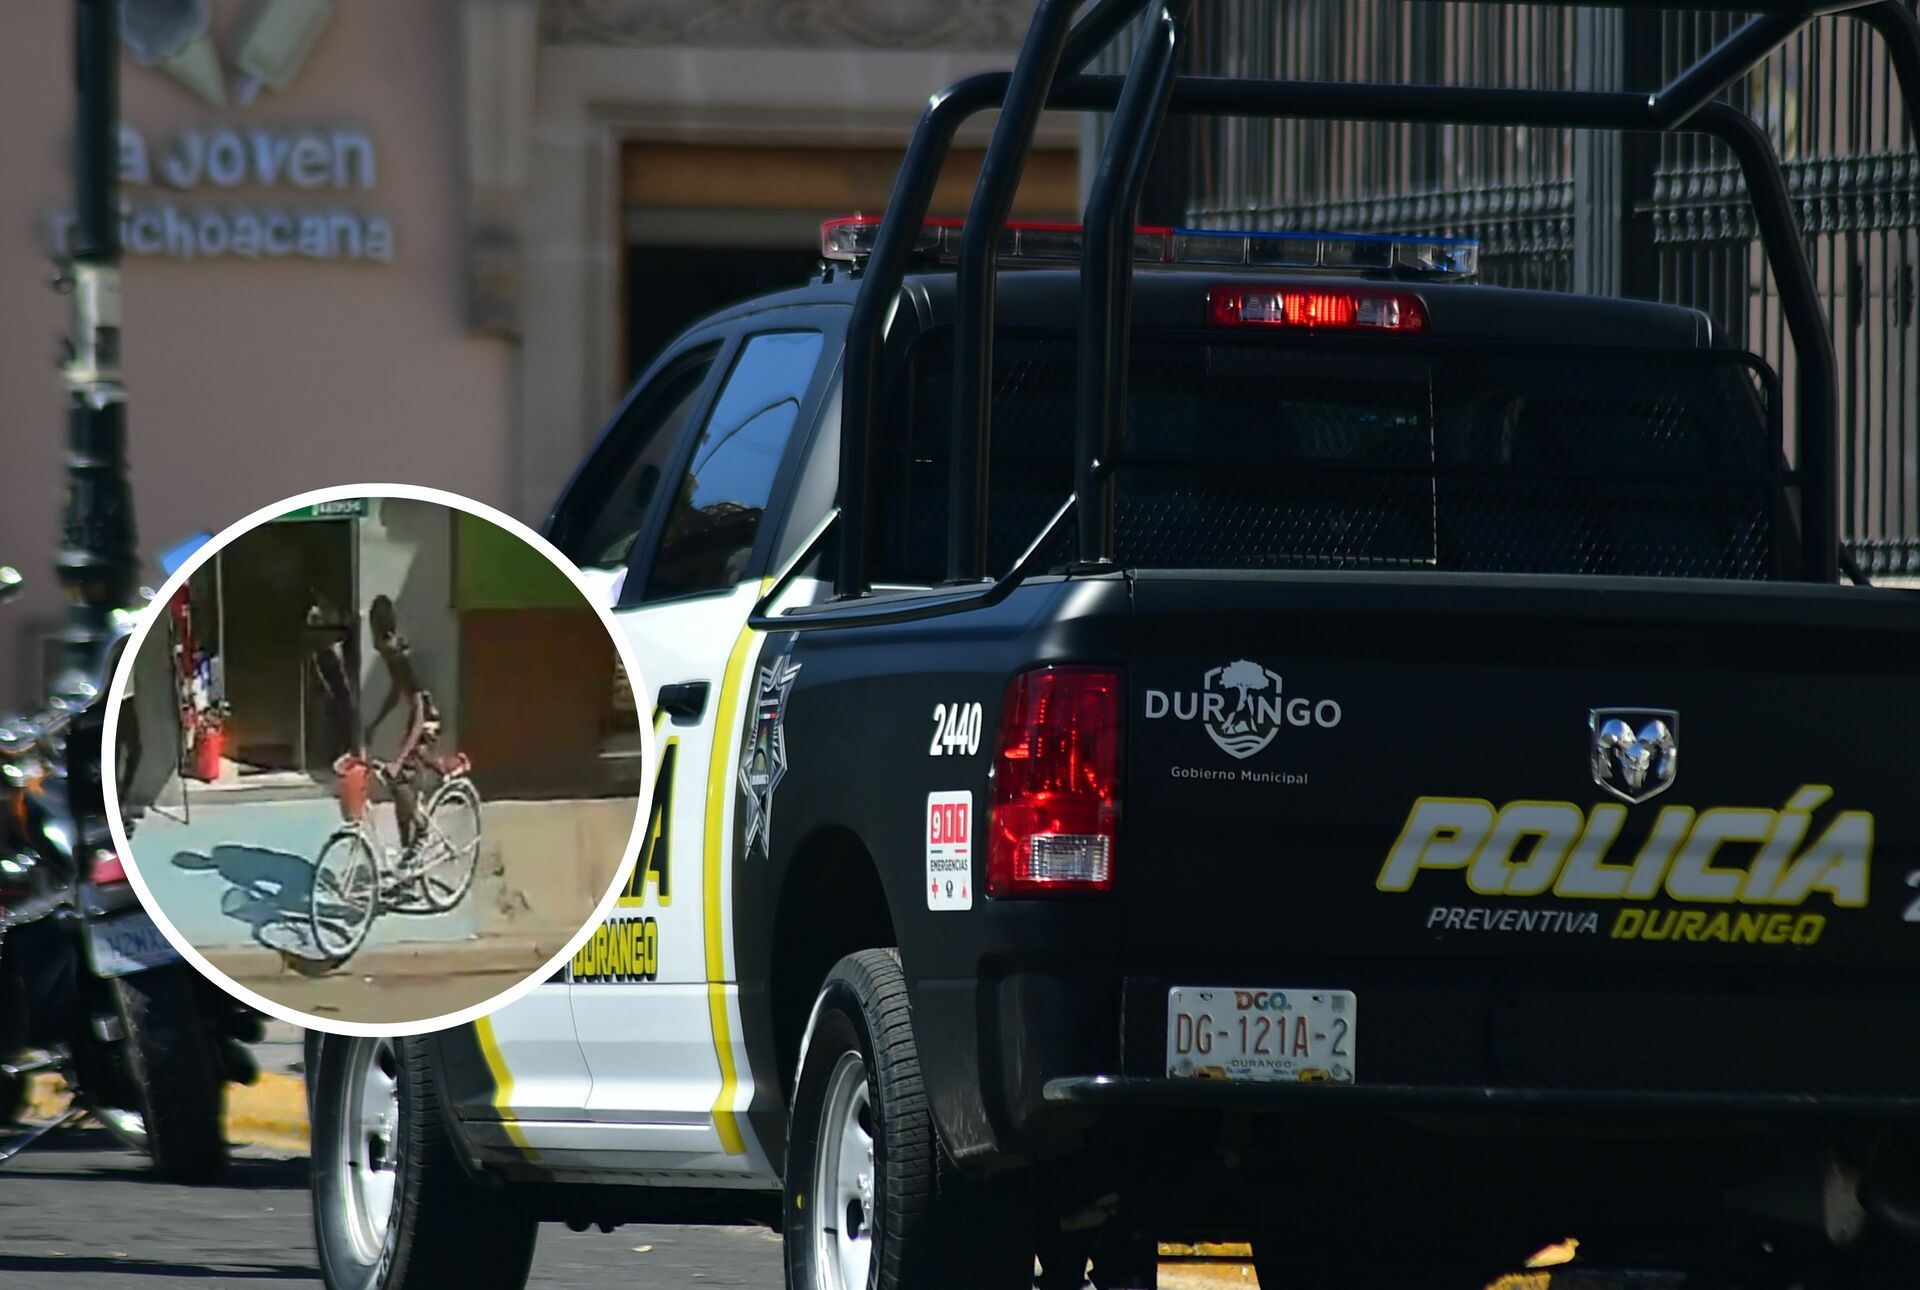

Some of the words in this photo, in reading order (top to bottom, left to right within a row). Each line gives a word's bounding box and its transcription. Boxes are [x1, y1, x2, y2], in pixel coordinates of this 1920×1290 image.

[164, 127, 378, 190] Joven
[1145, 689, 1342, 729] DURANGO
[930, 702, 983, 756] 2440
[1171, 766, 1236, 781] Gobierno
[1241, 770, 1308, 785] Municipal
[930, 806, 968, 844] 911
[930, 859, 968, 872] EMERGENCIAS
[1376, 784, 1875, 909] POLICÍA
[1426, 906, 1599, 935] PREVENTIVA
[1610, 908, 1827, 945] DURANGO
[1176, 1013, 1349, 1058] DG-121A-2
[1231, 1059, 1292, 1069] DURANGO
